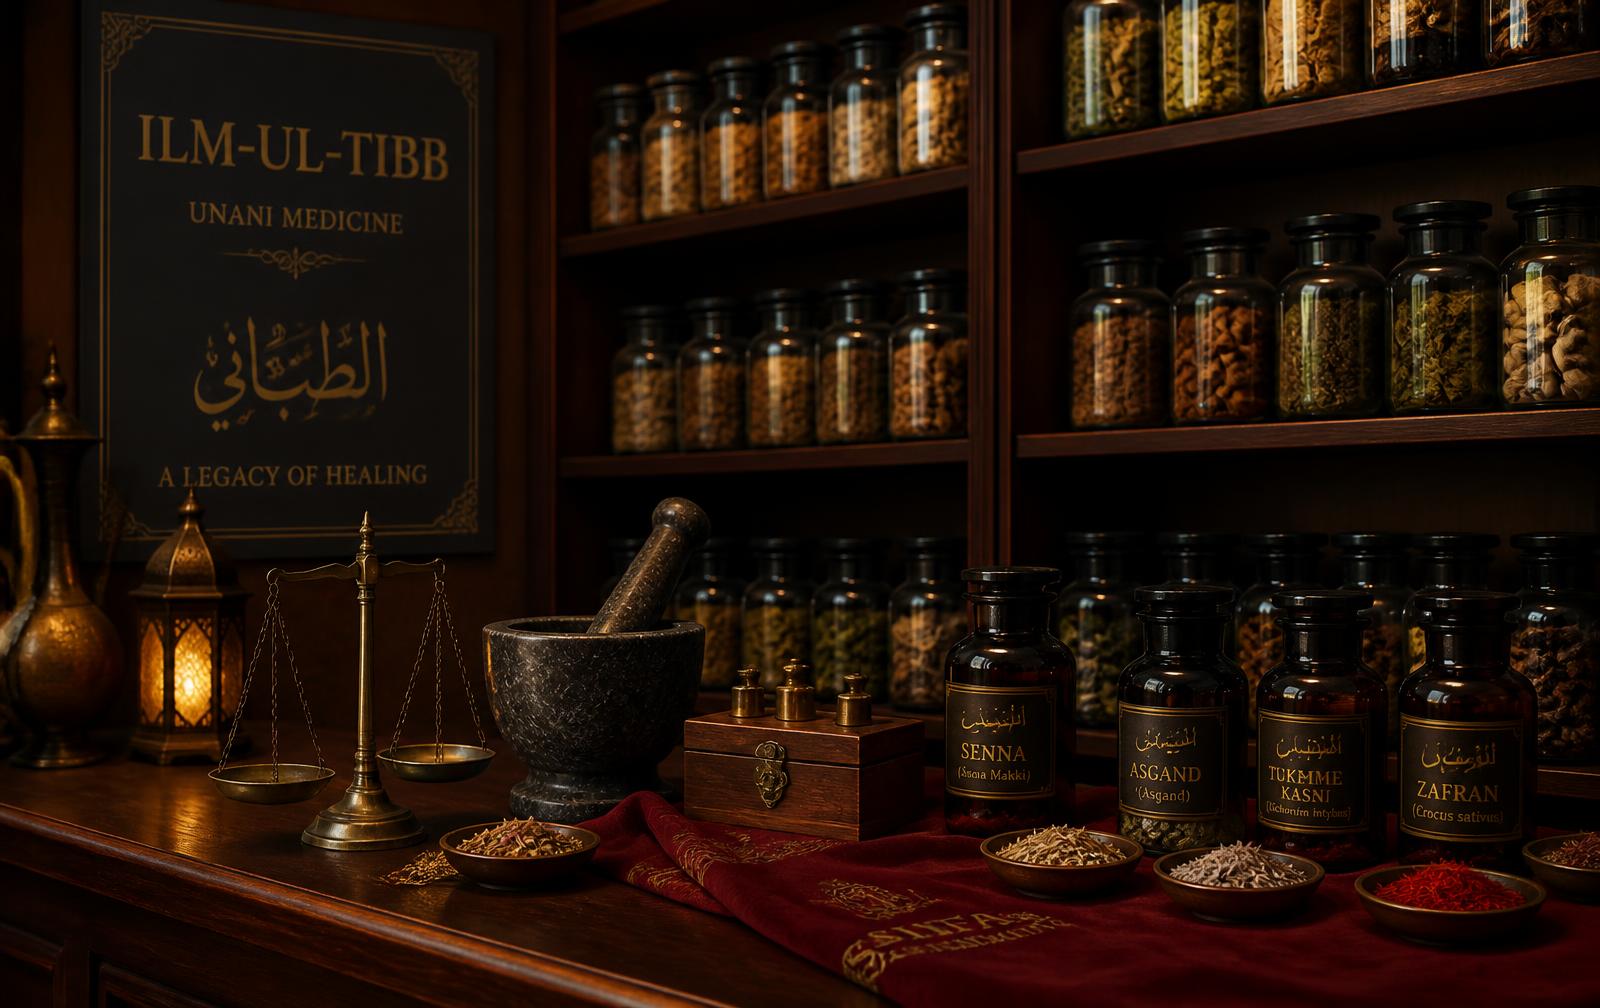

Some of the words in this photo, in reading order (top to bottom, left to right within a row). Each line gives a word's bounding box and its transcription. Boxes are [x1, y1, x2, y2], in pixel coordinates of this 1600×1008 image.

[138, 114, 449, 182] ILM-UL-TIBB
[189, 201, 273, 227] UNANI
[282, 207, 404, 235] MEDICINE
[158, 466, 175, 488] A
[183, 466, 280, 488] LEGACY
[287, 466, 318, 486] OF
[326, 464, 428, 486] HEALING
[961, 742, 1027, 762] SENNA
[1130, 762, 1202, 783] ASGAND
[1280, 786, 1331, 804] KASNI
[1417, 780, 1500, 803] ZAFRAN
